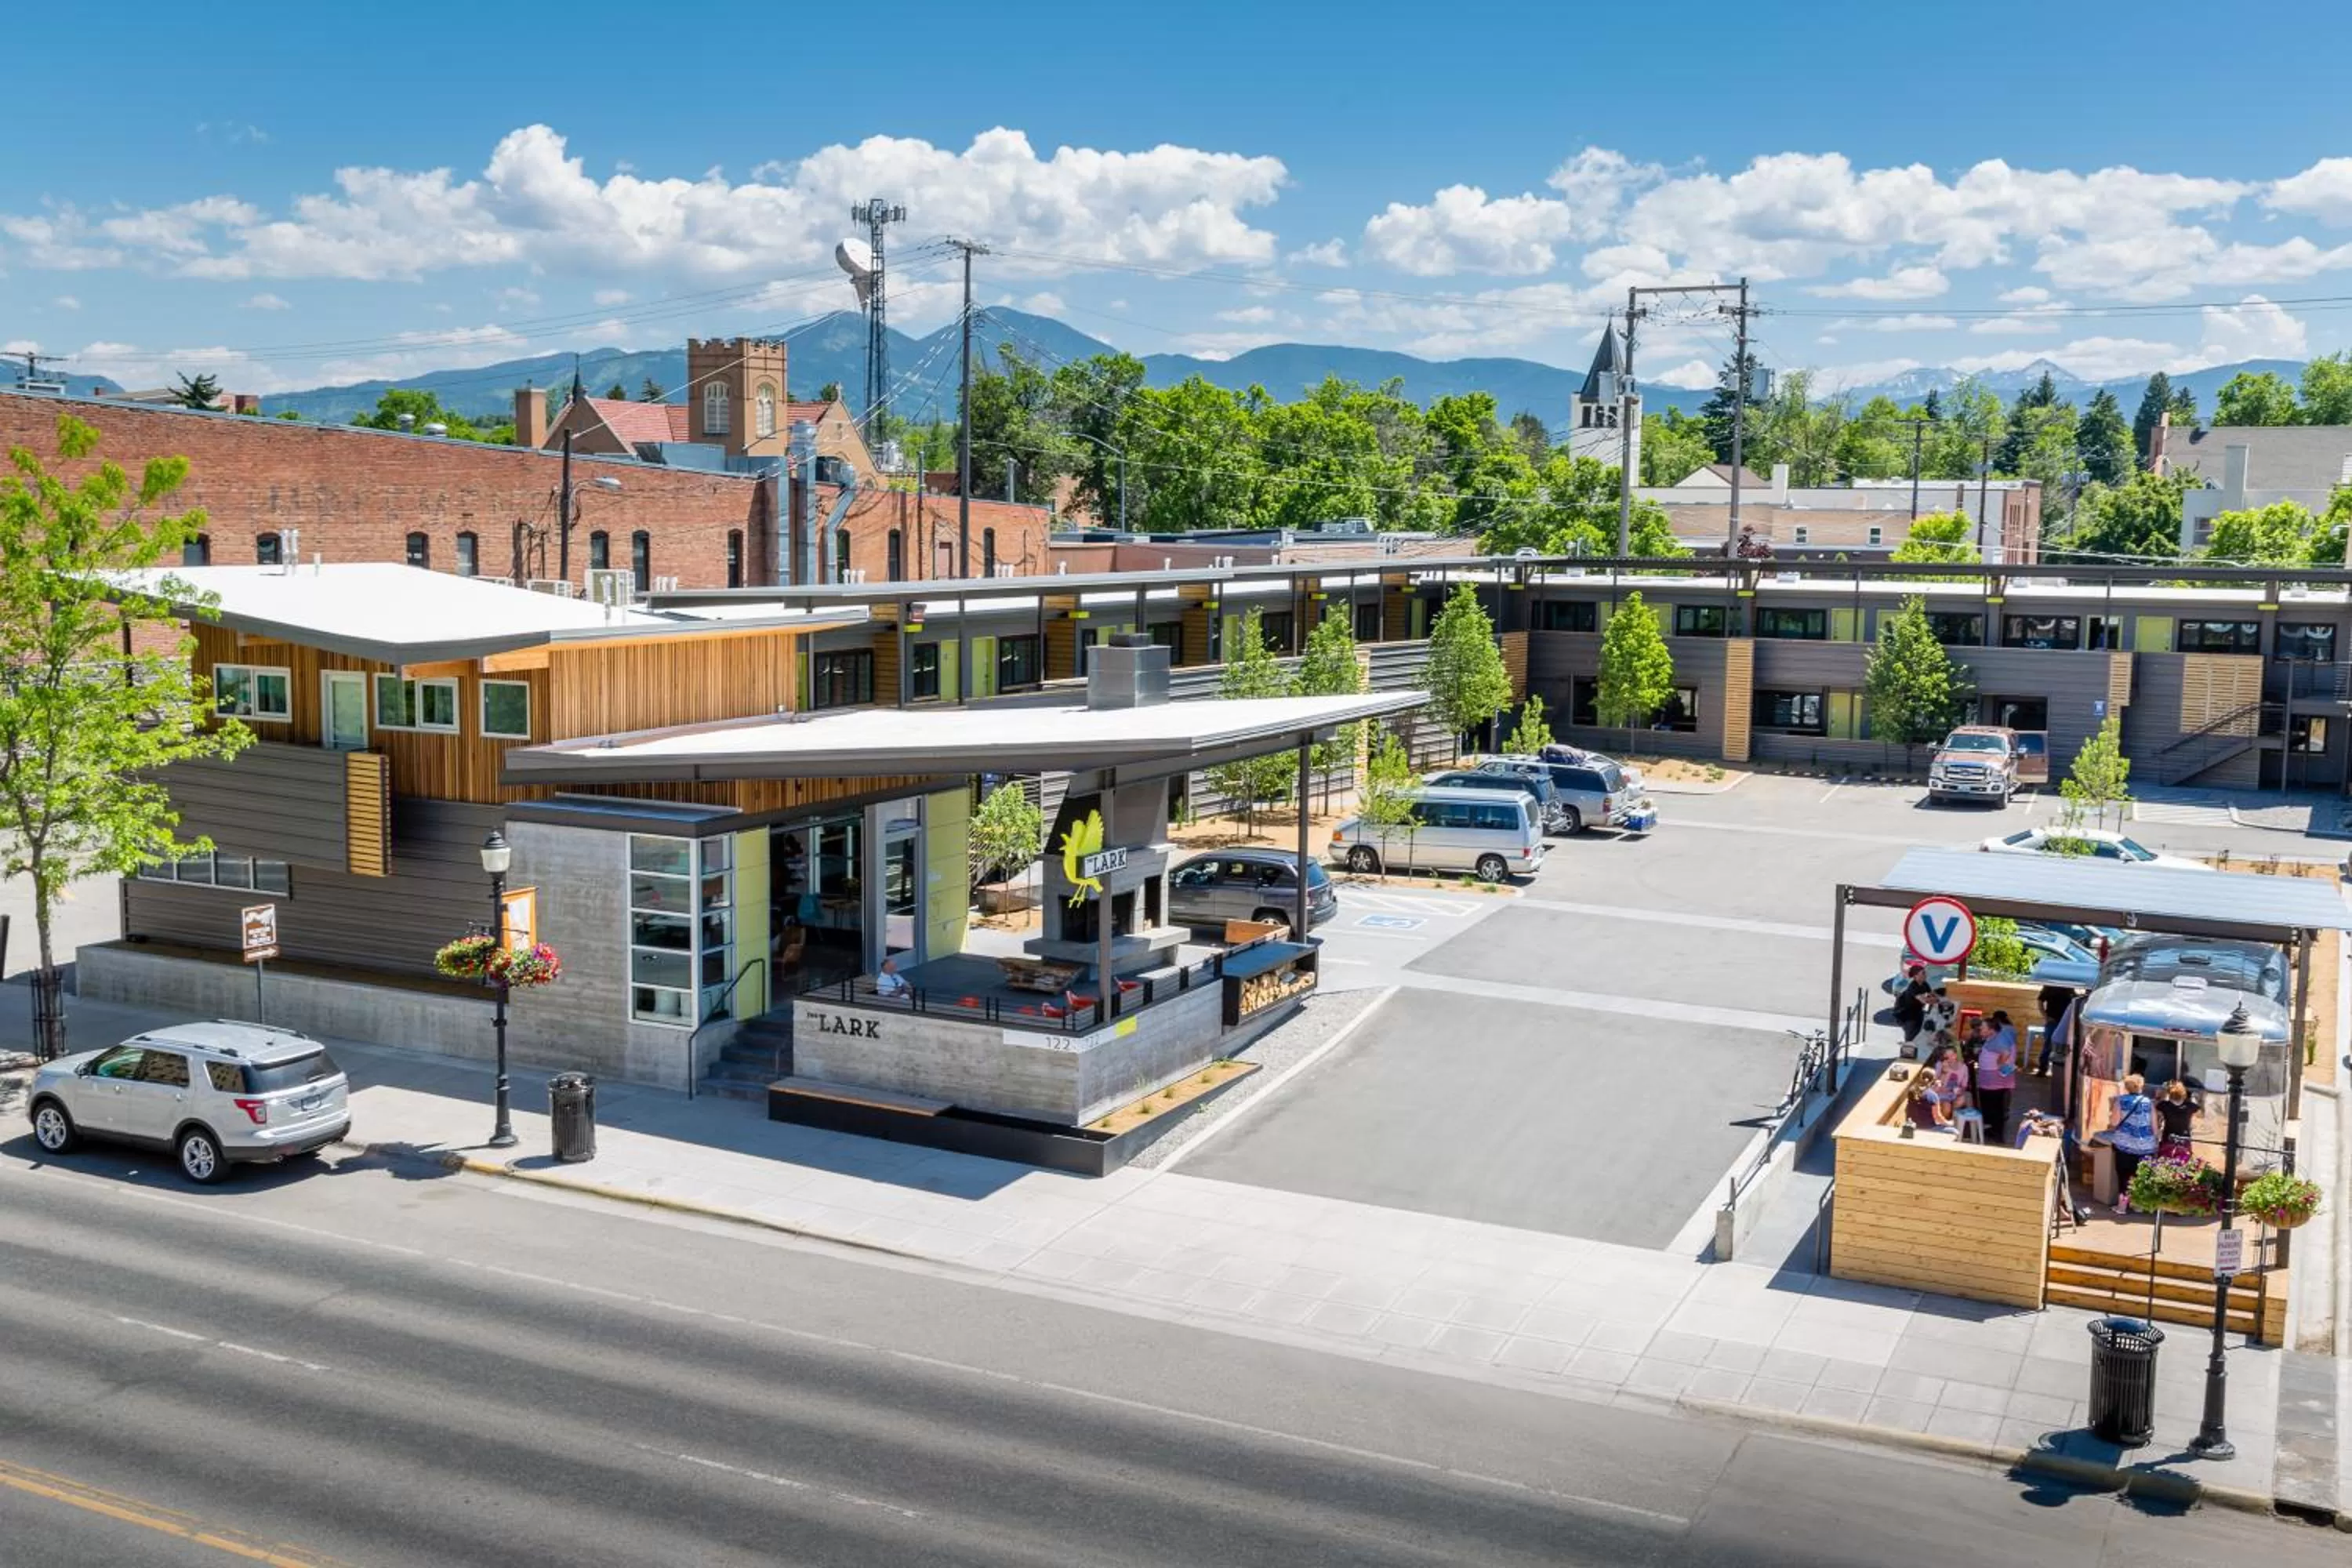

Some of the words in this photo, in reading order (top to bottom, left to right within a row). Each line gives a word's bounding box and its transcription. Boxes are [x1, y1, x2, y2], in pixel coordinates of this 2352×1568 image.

[1094, 850, 1125, 873] LARK
[1921, 914, 1959, 953] V
[819, 1014, 880, 1039] LARK
[1045, 1036, 1070, 1050] 122
